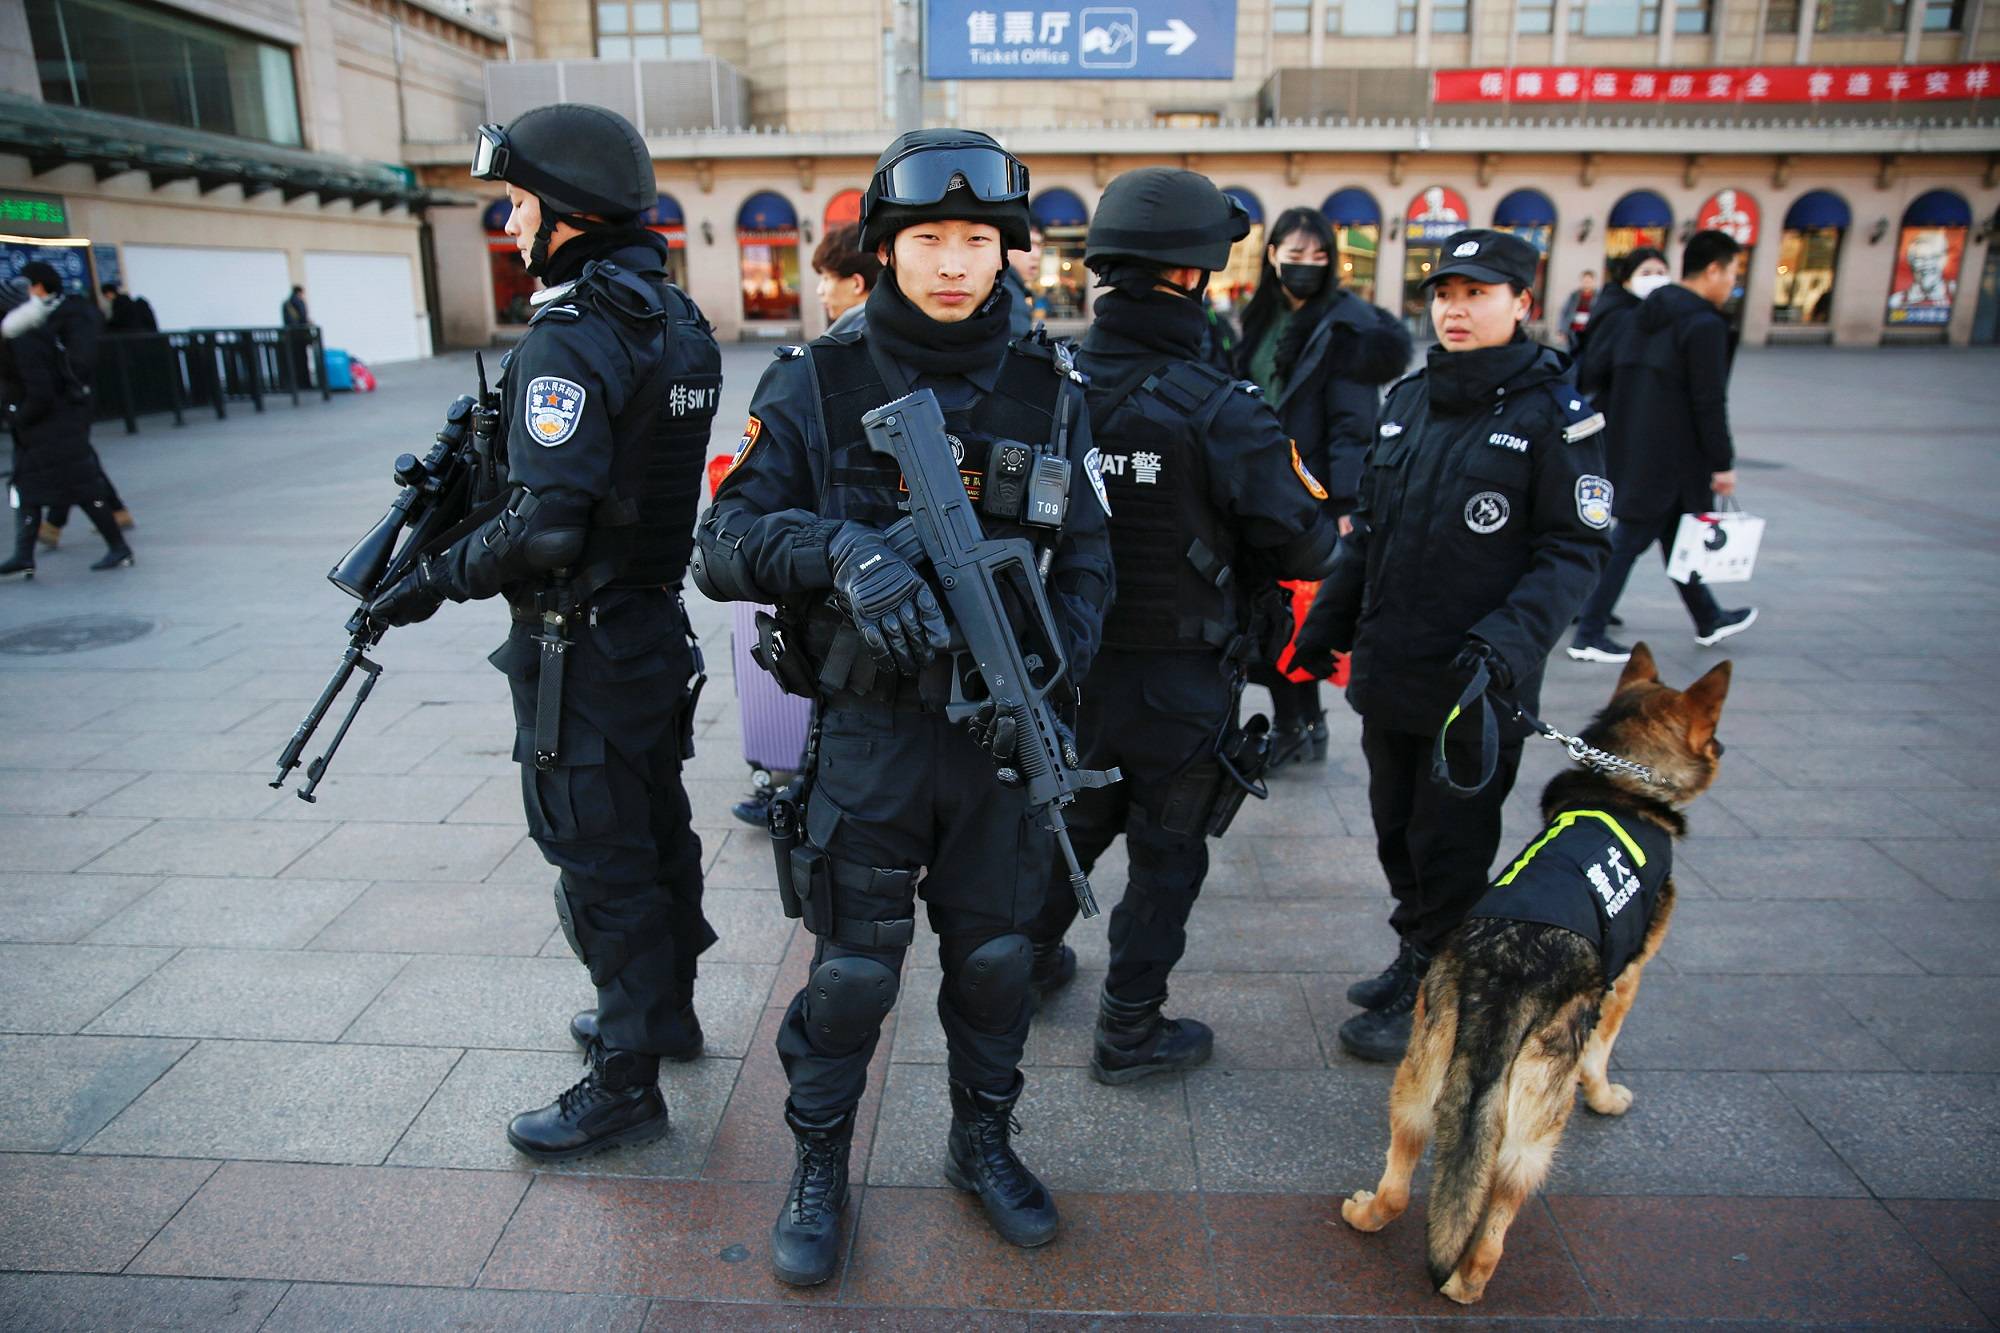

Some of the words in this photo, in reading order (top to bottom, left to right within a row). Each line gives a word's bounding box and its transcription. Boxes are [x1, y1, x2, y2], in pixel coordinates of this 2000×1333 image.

[967, 10, 1071, 45] 售票厅
[969, 48, 1019, 64] Ticket
[1021, 48, 1070, 64] Office
[1037, 500, 1059, 515] T09
